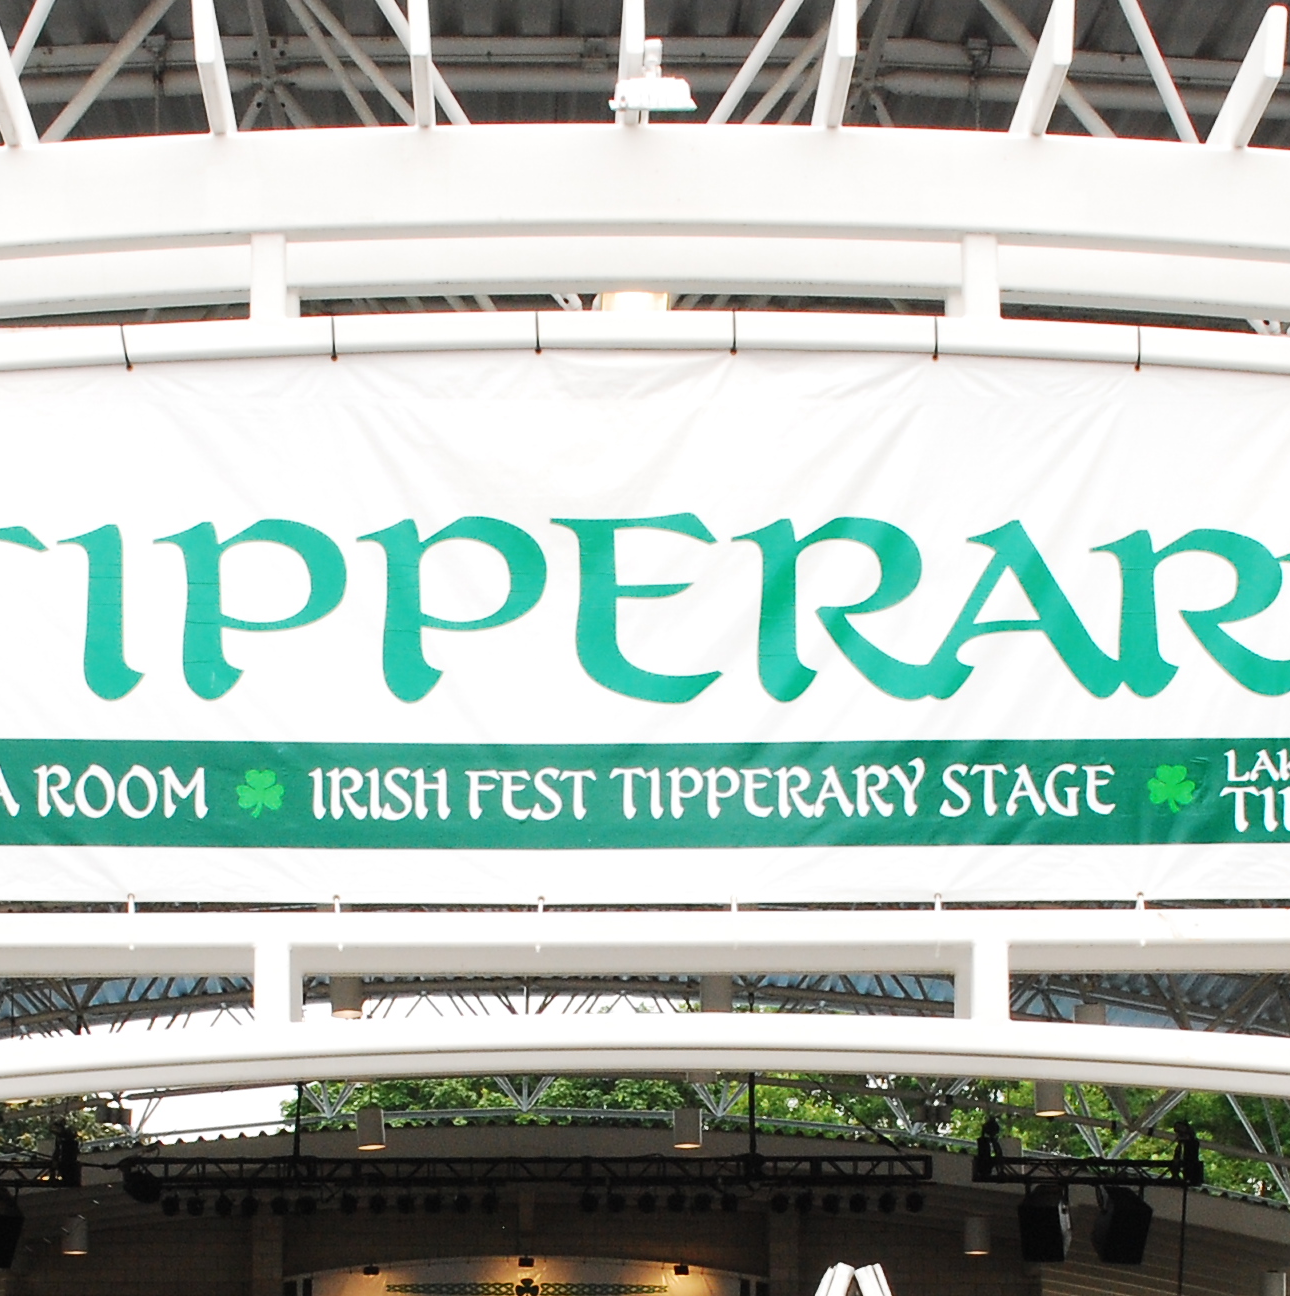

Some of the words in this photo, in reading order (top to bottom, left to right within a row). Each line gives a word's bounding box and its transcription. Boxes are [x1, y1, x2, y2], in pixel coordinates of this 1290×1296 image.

[34, 763, 208, 818] ROOM
[309, 766, 451, 820] IRISH
[464, 766, 596, 820] FEST
[609, 757, 925, 819] TIPPERARY
[939, 763, 1116, 818] STAGE
